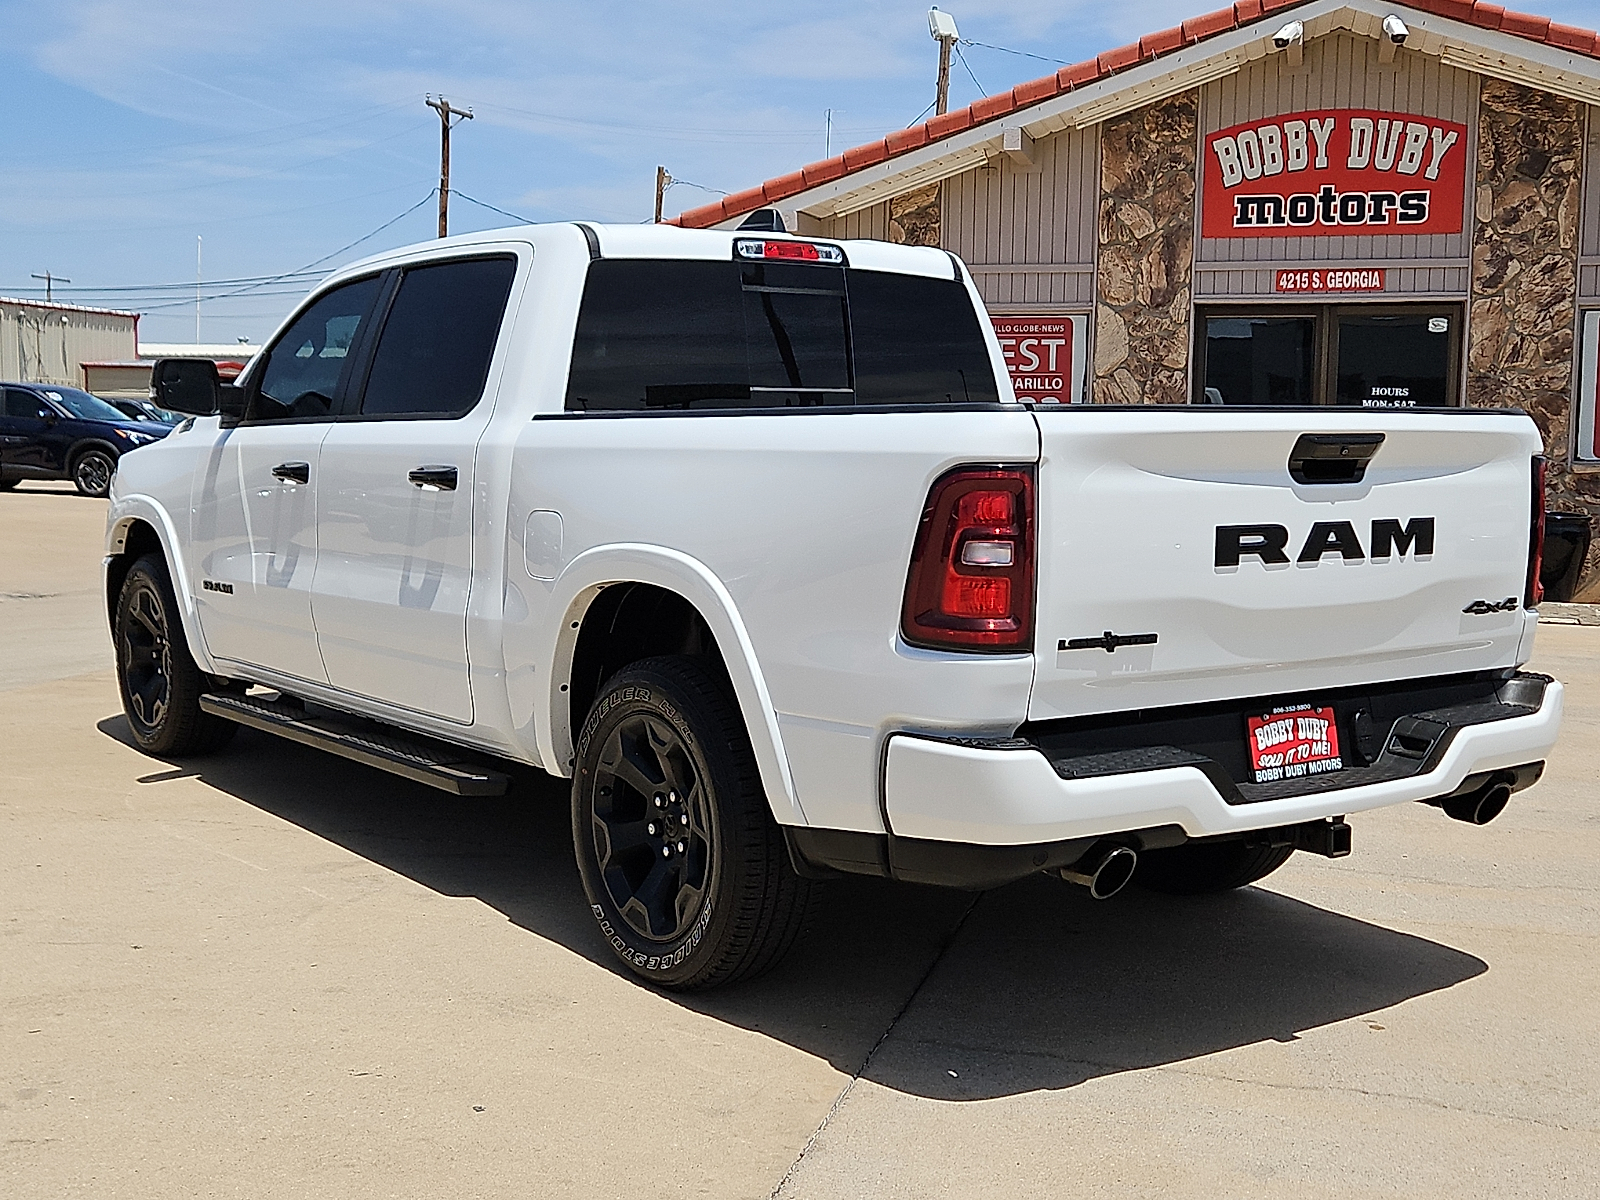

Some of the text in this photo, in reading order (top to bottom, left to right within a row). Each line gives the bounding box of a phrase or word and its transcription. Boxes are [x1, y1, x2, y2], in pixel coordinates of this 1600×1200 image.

[1212, 117, 1459, 188] BOBBY DUBY
[1233, 184, 1431, 228] motors
[1279, 271, 1380, 288] 4215 S. GEORGIA
[1013, 324, 1065, 332] GLOBE-NEWS
[1362, 399, 1416, 408] MON-SAT
[1371, 387, 1409, 396] HOURS
[1214, 517, 1436, 568] RAM
[1461, 597, 1519, 615] 4x4
[1255, 718, 1329, 751] BOBBY DUBY
[1258, 753, 1284, 768] SOLD
[1286, 748, 1297, 765] IT
[1297, 743, 1310, 761] TO
[1255, 757, 1343, 783] BOBBY DUBY MOTORS
[590, 897, 712, 970] BRIDGESTONE
